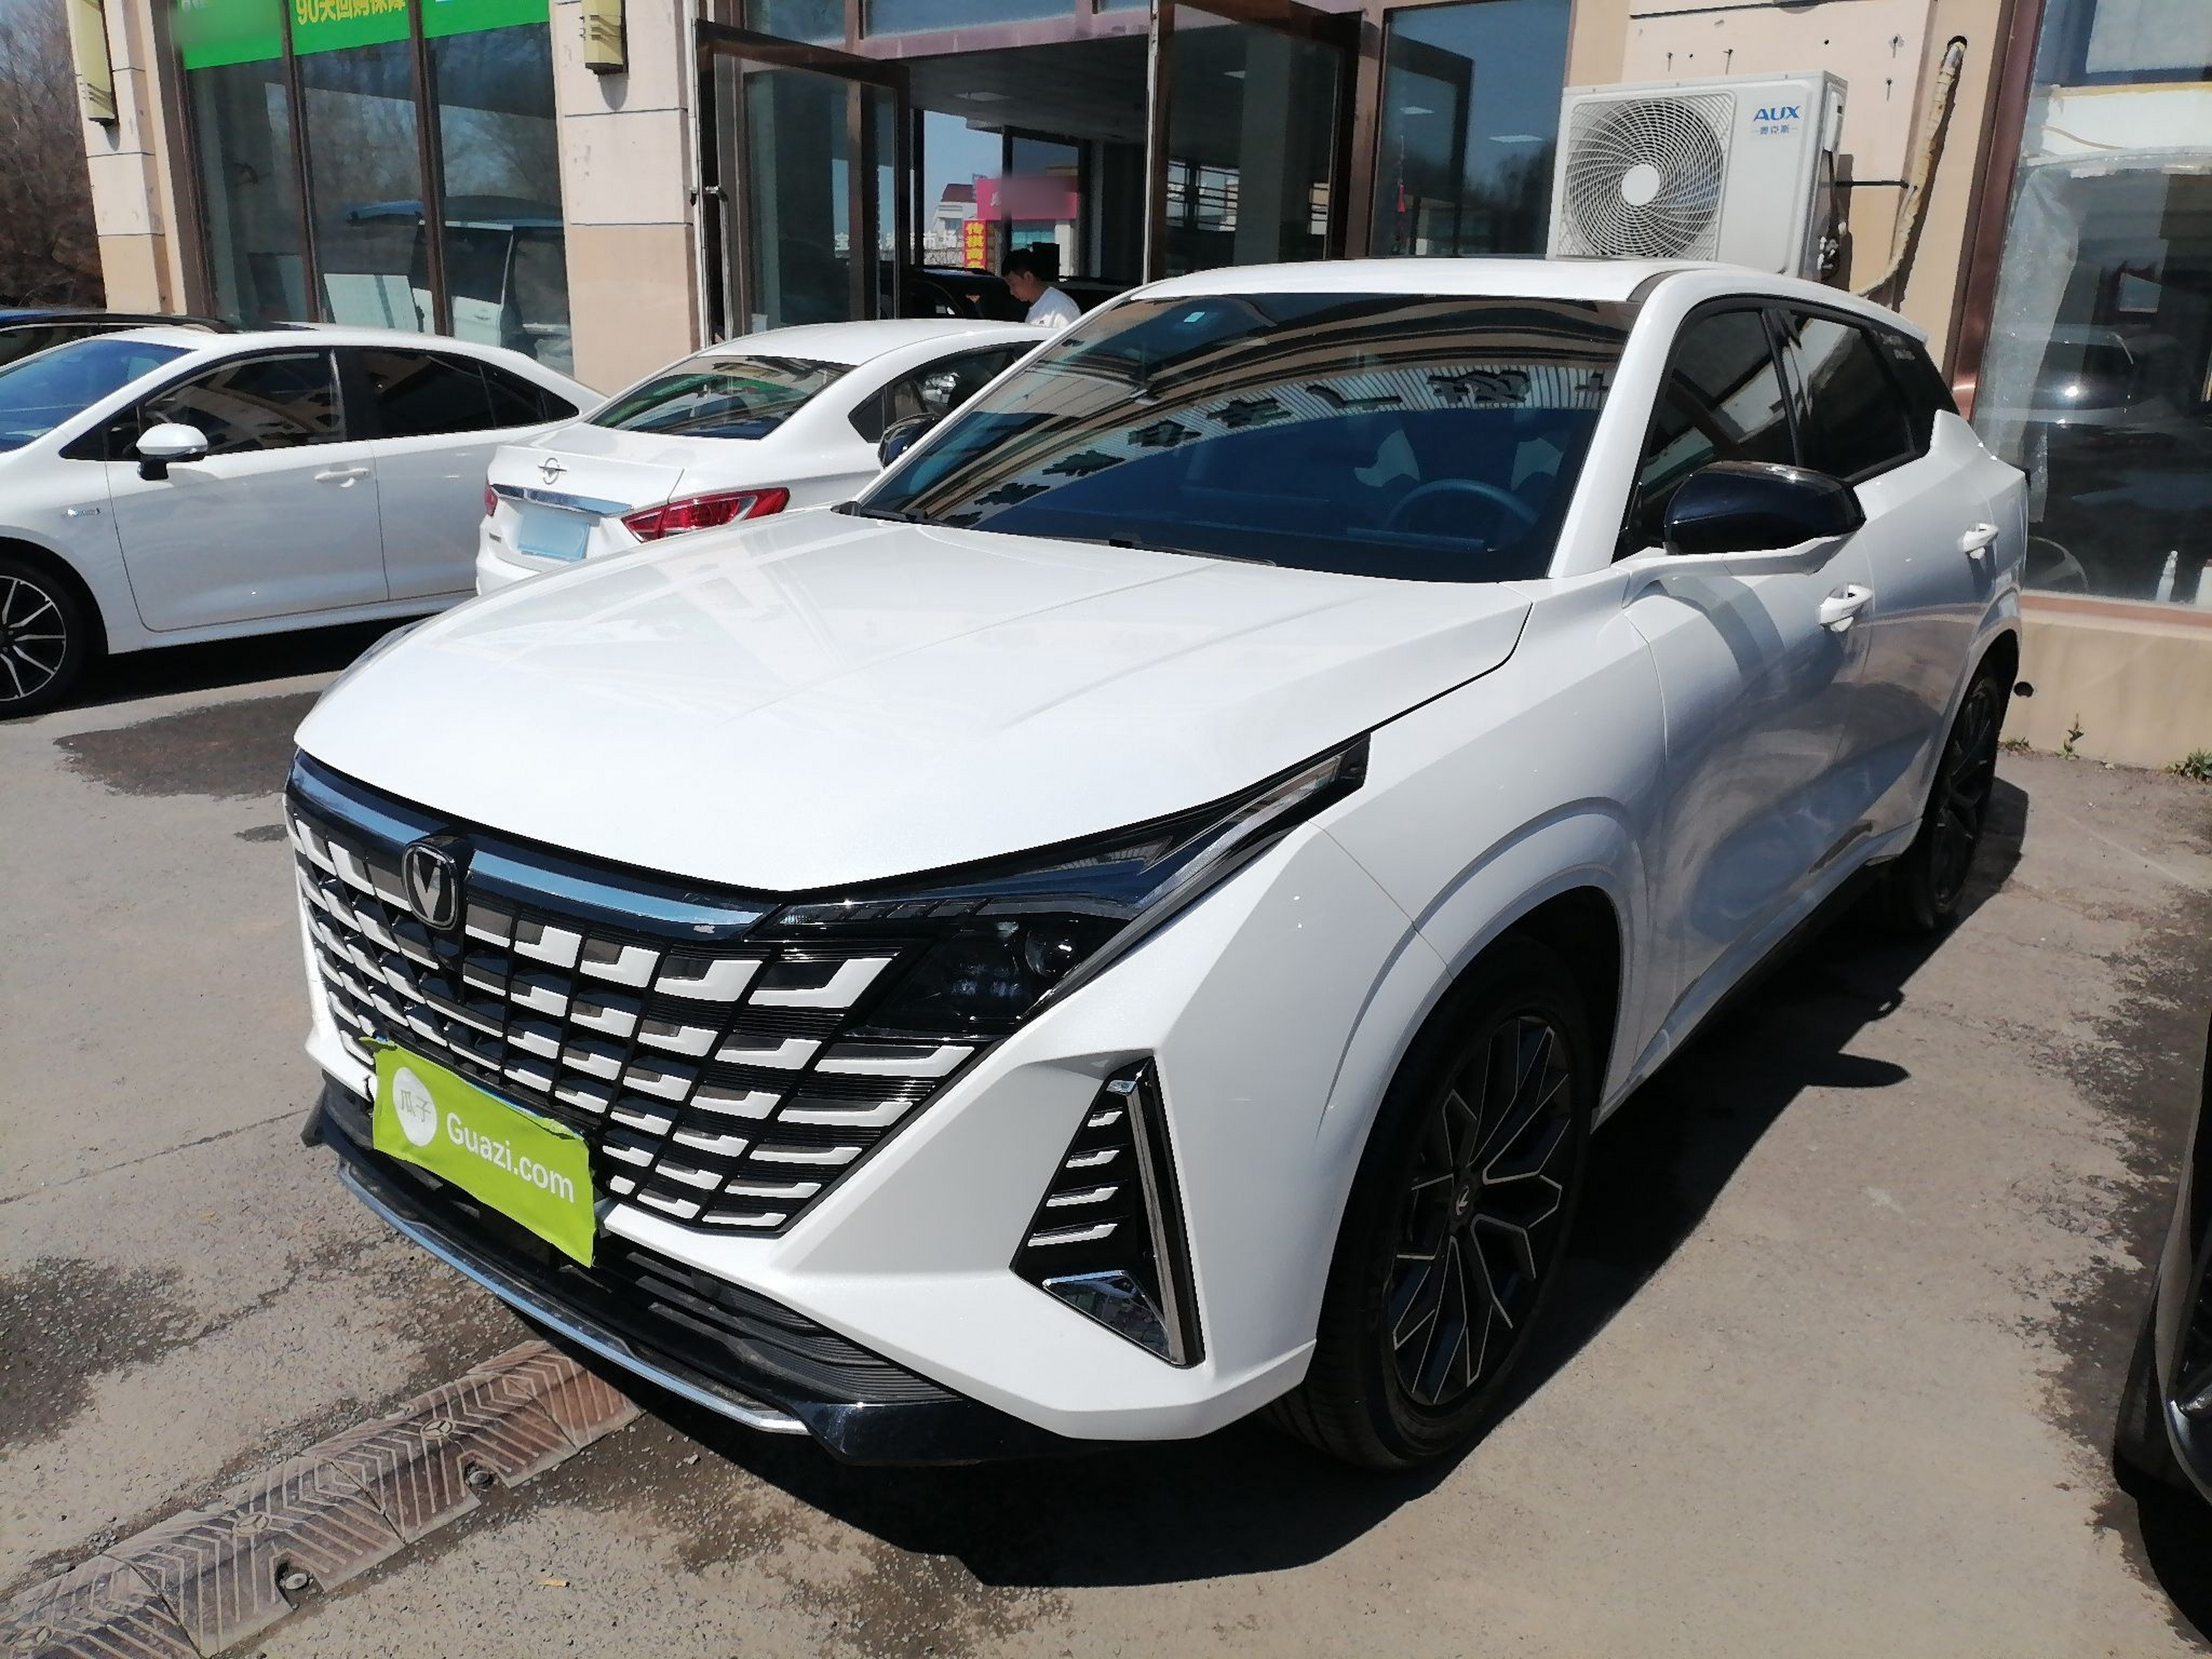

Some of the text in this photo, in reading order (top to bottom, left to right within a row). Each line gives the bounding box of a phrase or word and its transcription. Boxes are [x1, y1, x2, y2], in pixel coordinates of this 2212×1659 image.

[1753, 105, 1801, 122] AUX
[400, 1089, 431, 1123] 瓜子
[446, 1112, 574, 1203] Guazi.com
